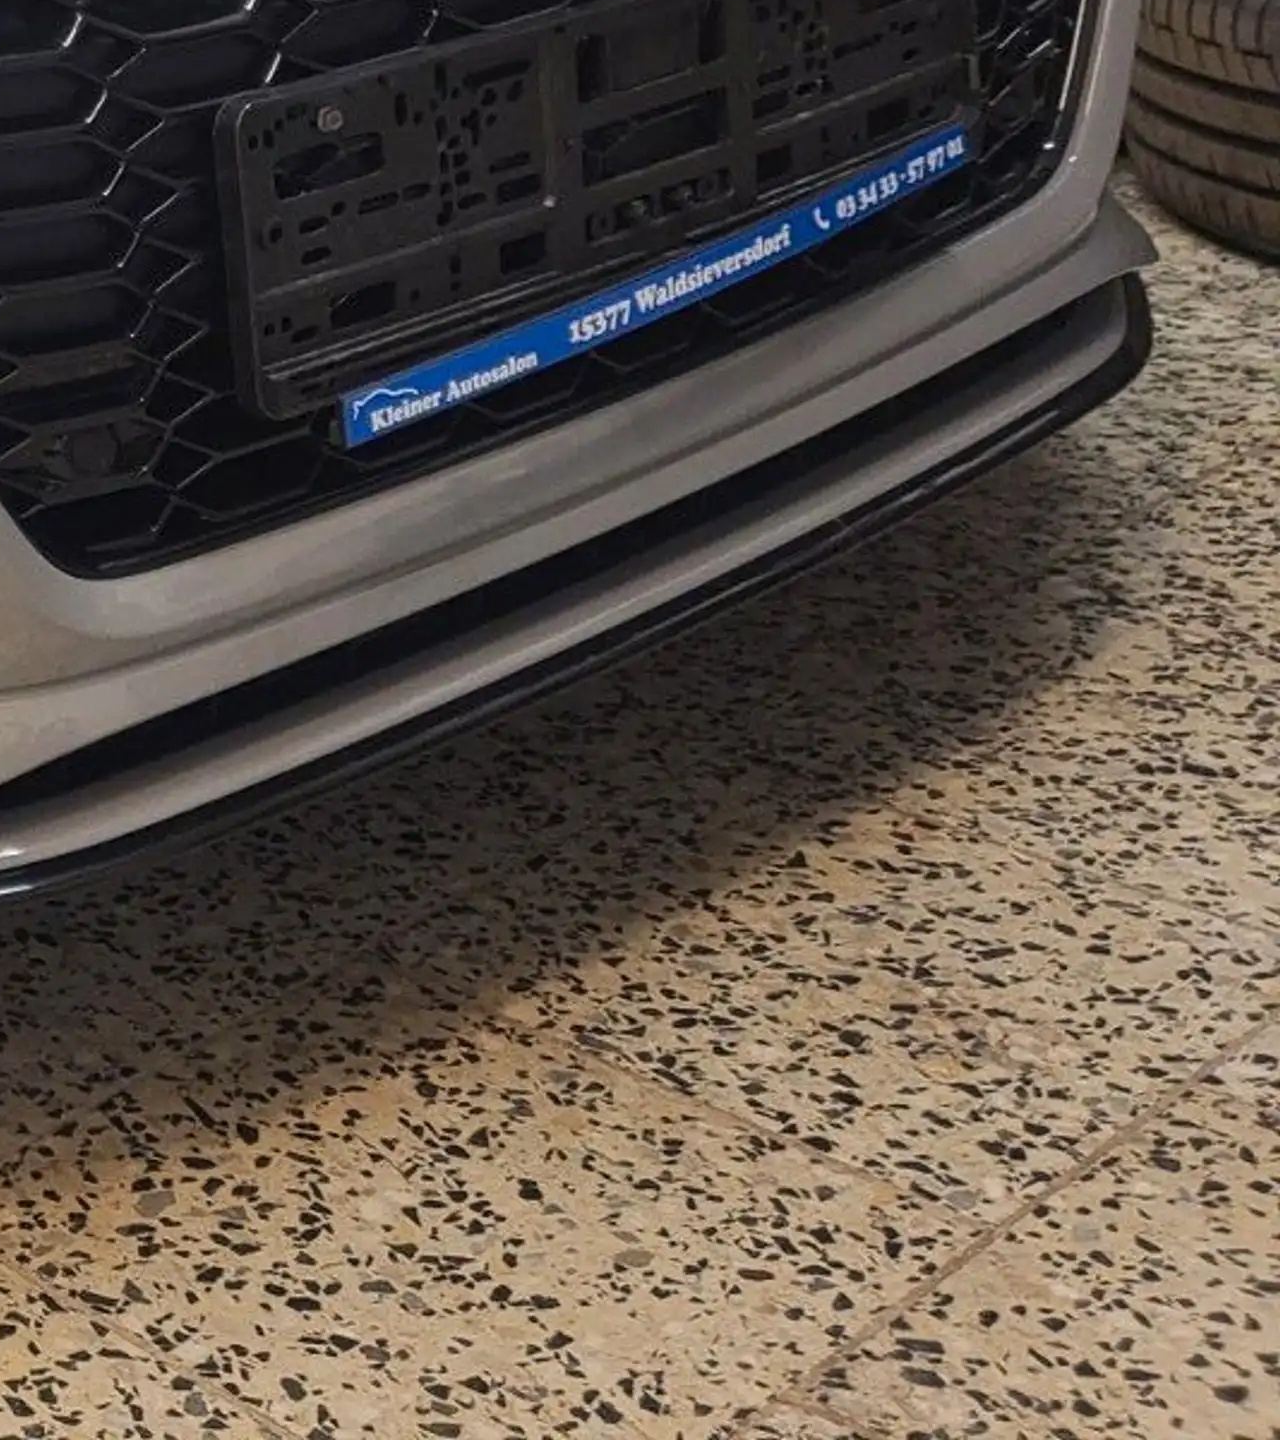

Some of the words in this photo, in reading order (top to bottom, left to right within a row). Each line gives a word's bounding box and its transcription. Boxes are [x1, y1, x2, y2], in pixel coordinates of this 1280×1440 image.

[568, 299, 632, 344] 15377
[634, 222, 792, 313] Waldsieversdorf
[370, 391, 442, 433] Kleiner
[445, 351, 539, 402] Autosalon
